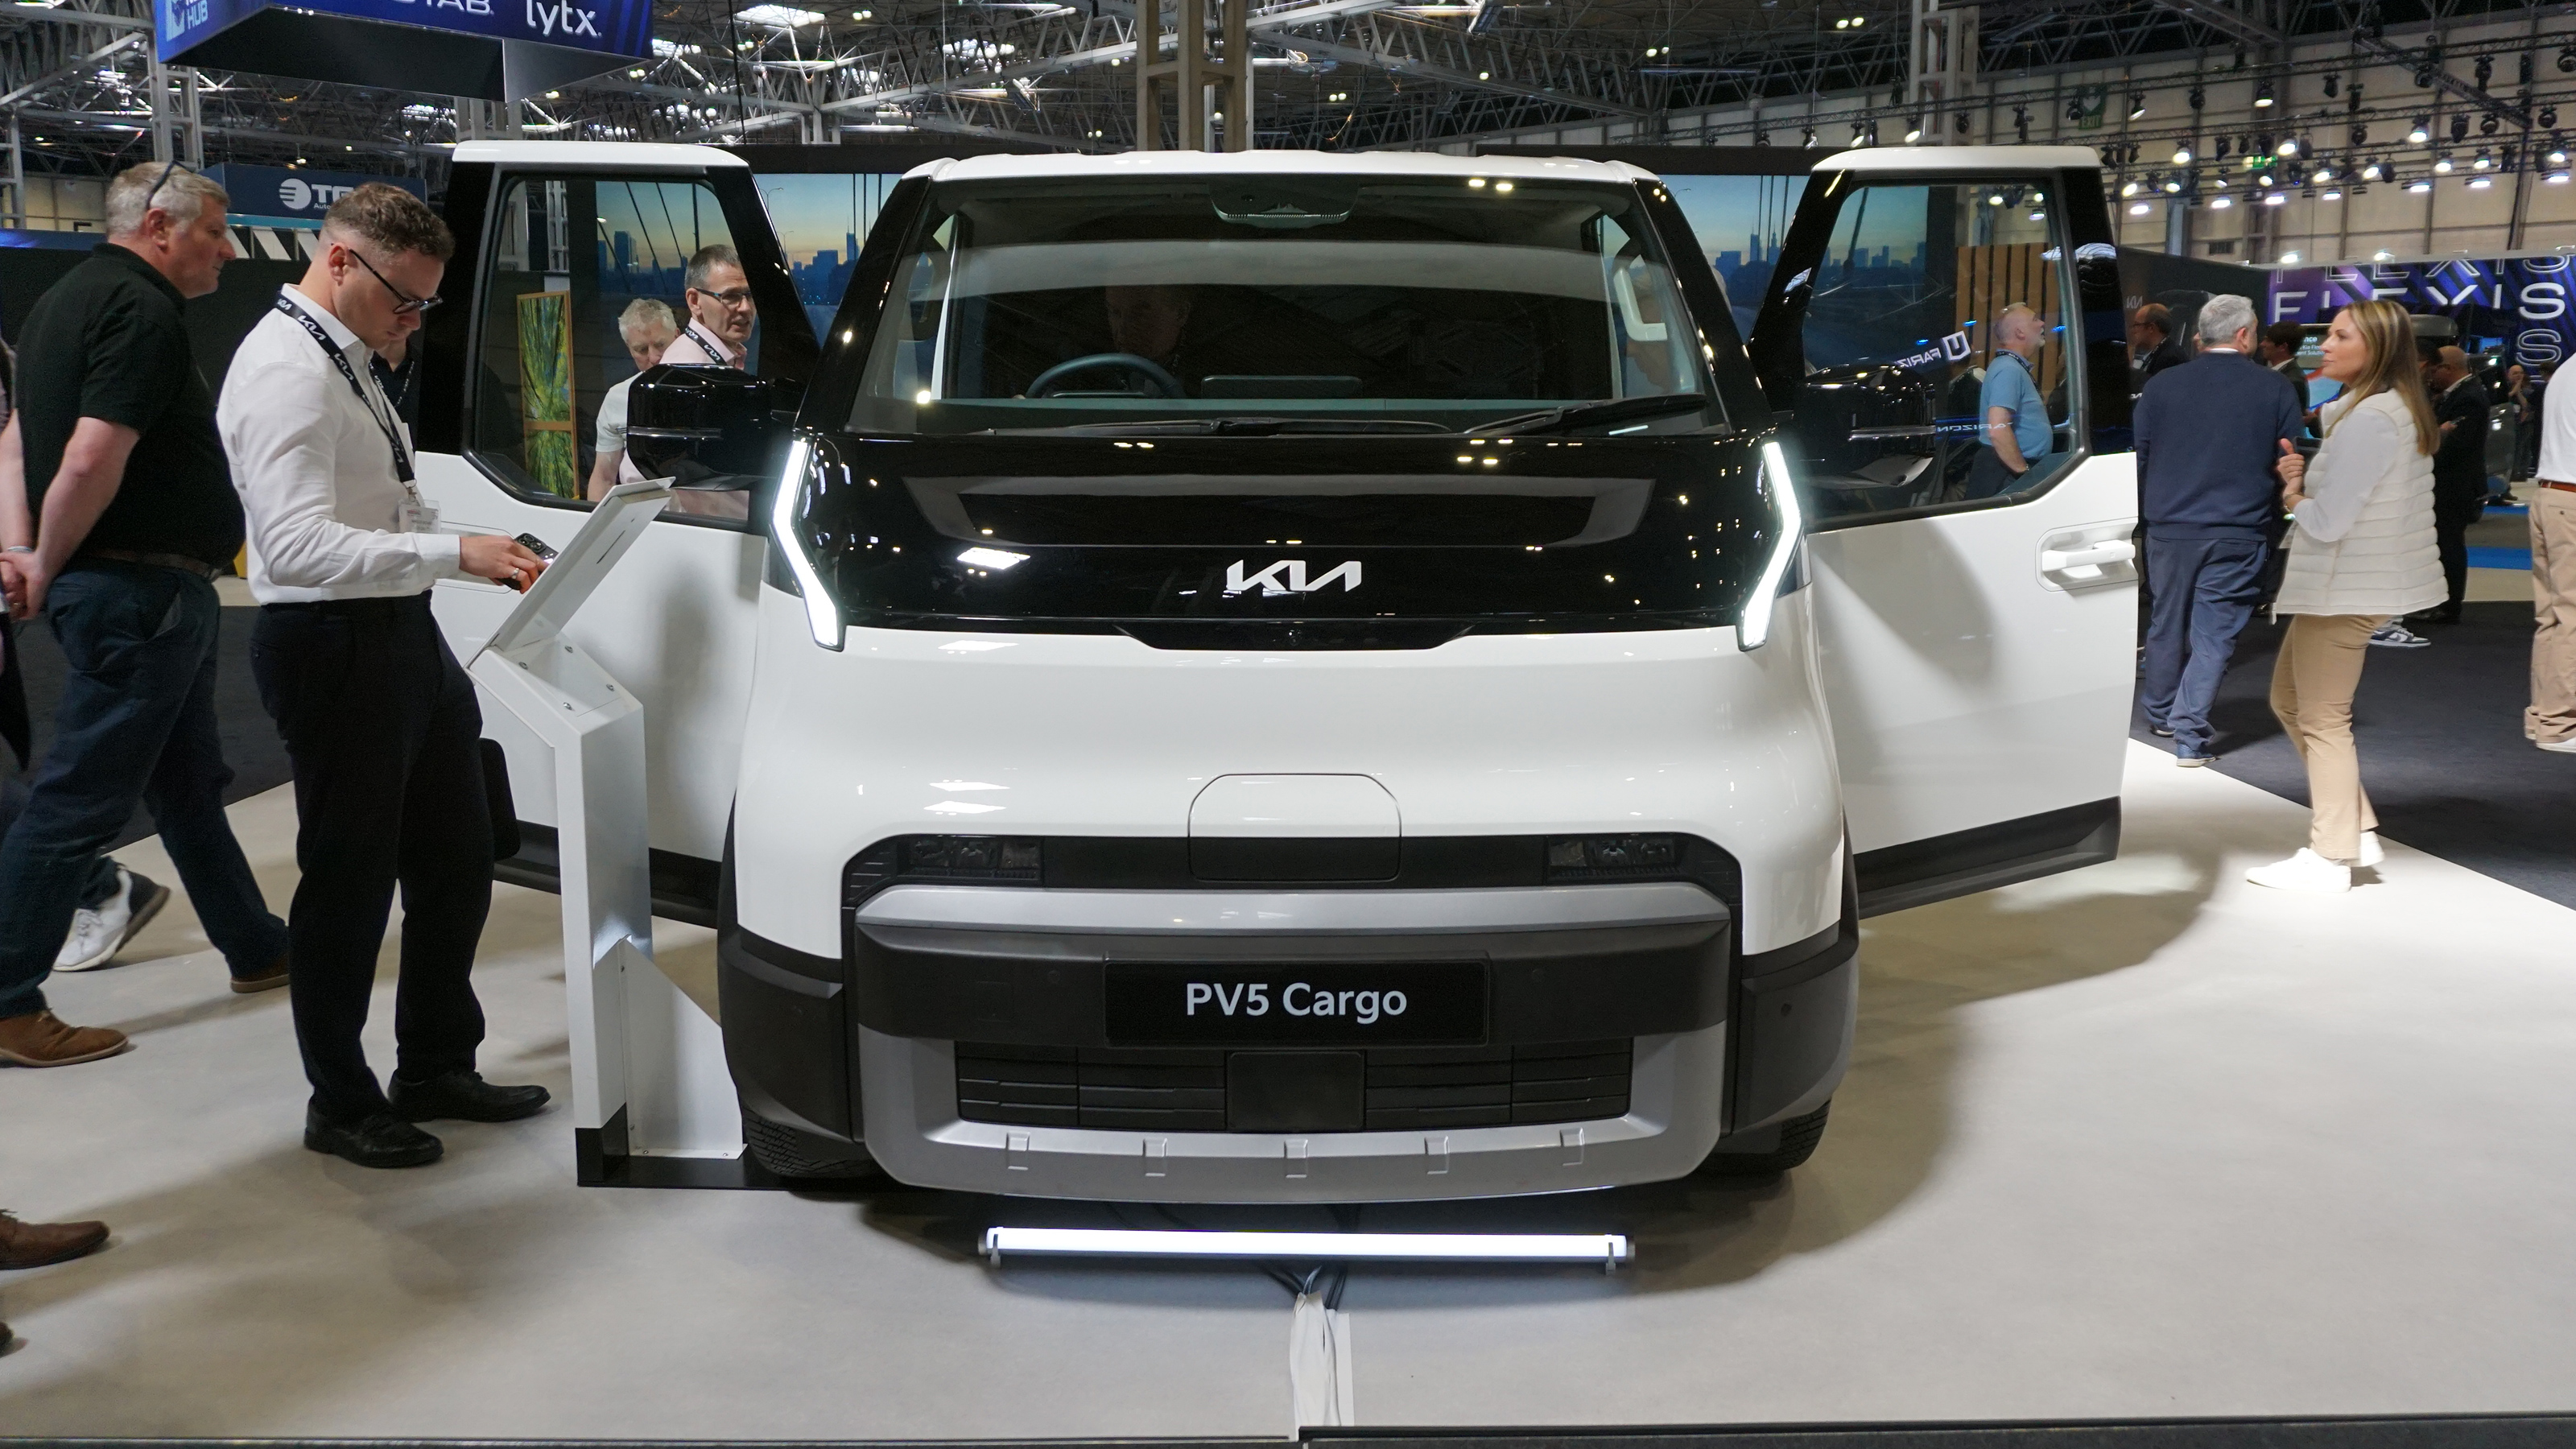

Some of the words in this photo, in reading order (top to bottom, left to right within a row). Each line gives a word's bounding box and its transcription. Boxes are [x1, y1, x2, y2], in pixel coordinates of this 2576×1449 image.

[187, 0, 208, 30] HUB
[297, 315, 327, 341] KIA
[333, 353, 354, 381] KIA
[1226, 559, 1362, 592] KIA
[1186, 982, 1270, 1016] PV5
[1282, 982, 1408, 1025] Cargo
